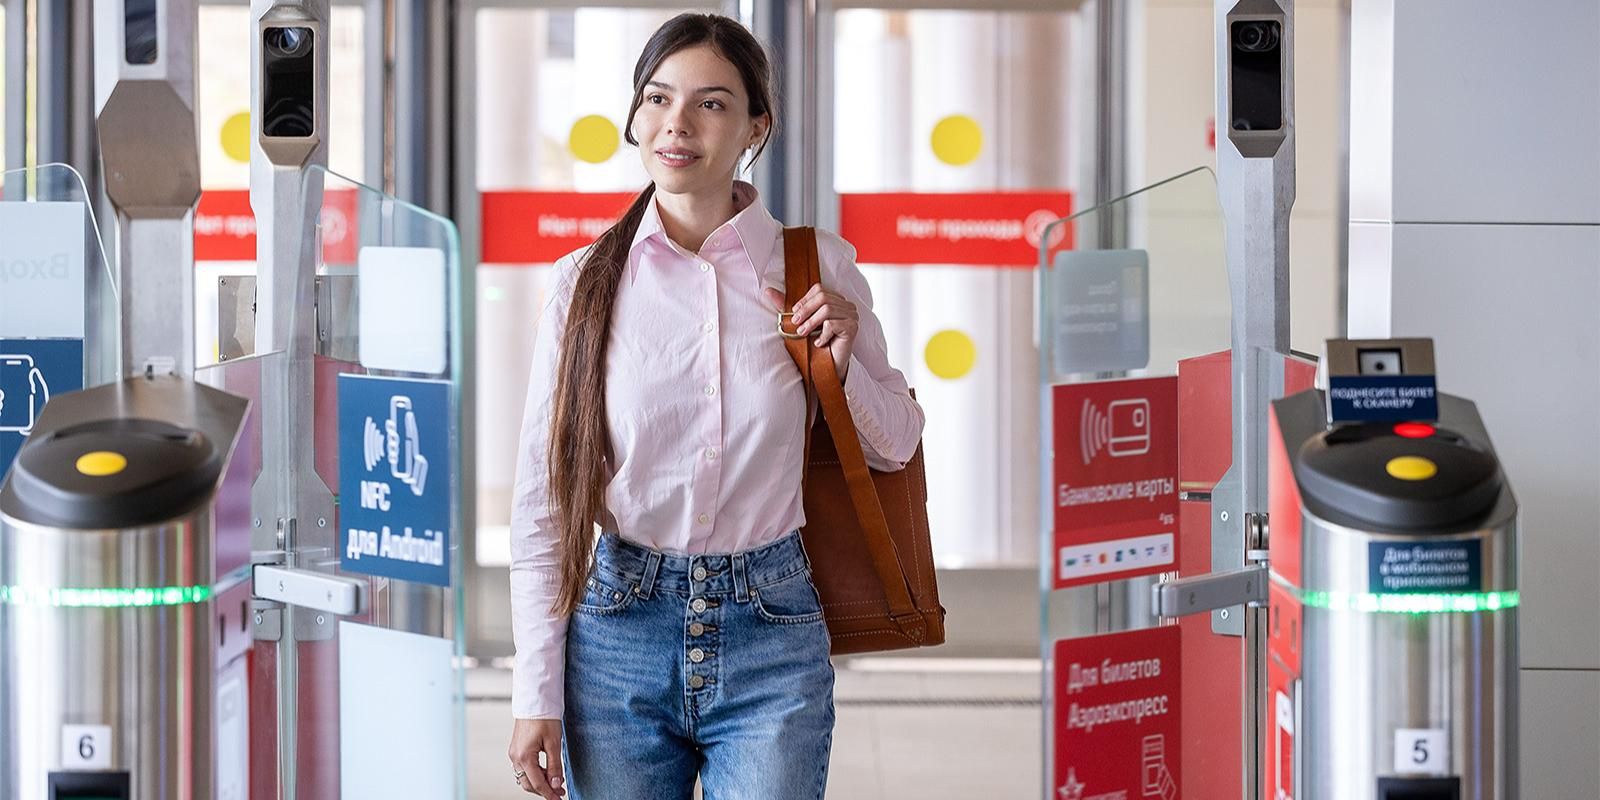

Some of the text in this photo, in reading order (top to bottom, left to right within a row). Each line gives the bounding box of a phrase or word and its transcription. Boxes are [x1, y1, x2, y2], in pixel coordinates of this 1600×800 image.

[897, 215, 1023, 242] Нет прохода
[1331, 386, 1434, 399] ПОДНЕСИТЕ БИЛЕТ
[1352, 398, 1416, 409] К СКАНЕРУ
[360, 480, 391, 512] NFC
[1059, 477, 1174, 507] Банковские карты
[346, 525, 444, 567] для Android
[1383, 546, 1468, 563] Для билетов
[1391, 562, 1470, 574] мобильном
[1066, 658, 1161, 695] Для билетов
[1066, 694, 1168, 733] Аэроэкспресс
[79, 734, 94, 760] 6
[1413, 739, 1428, 764] 5
